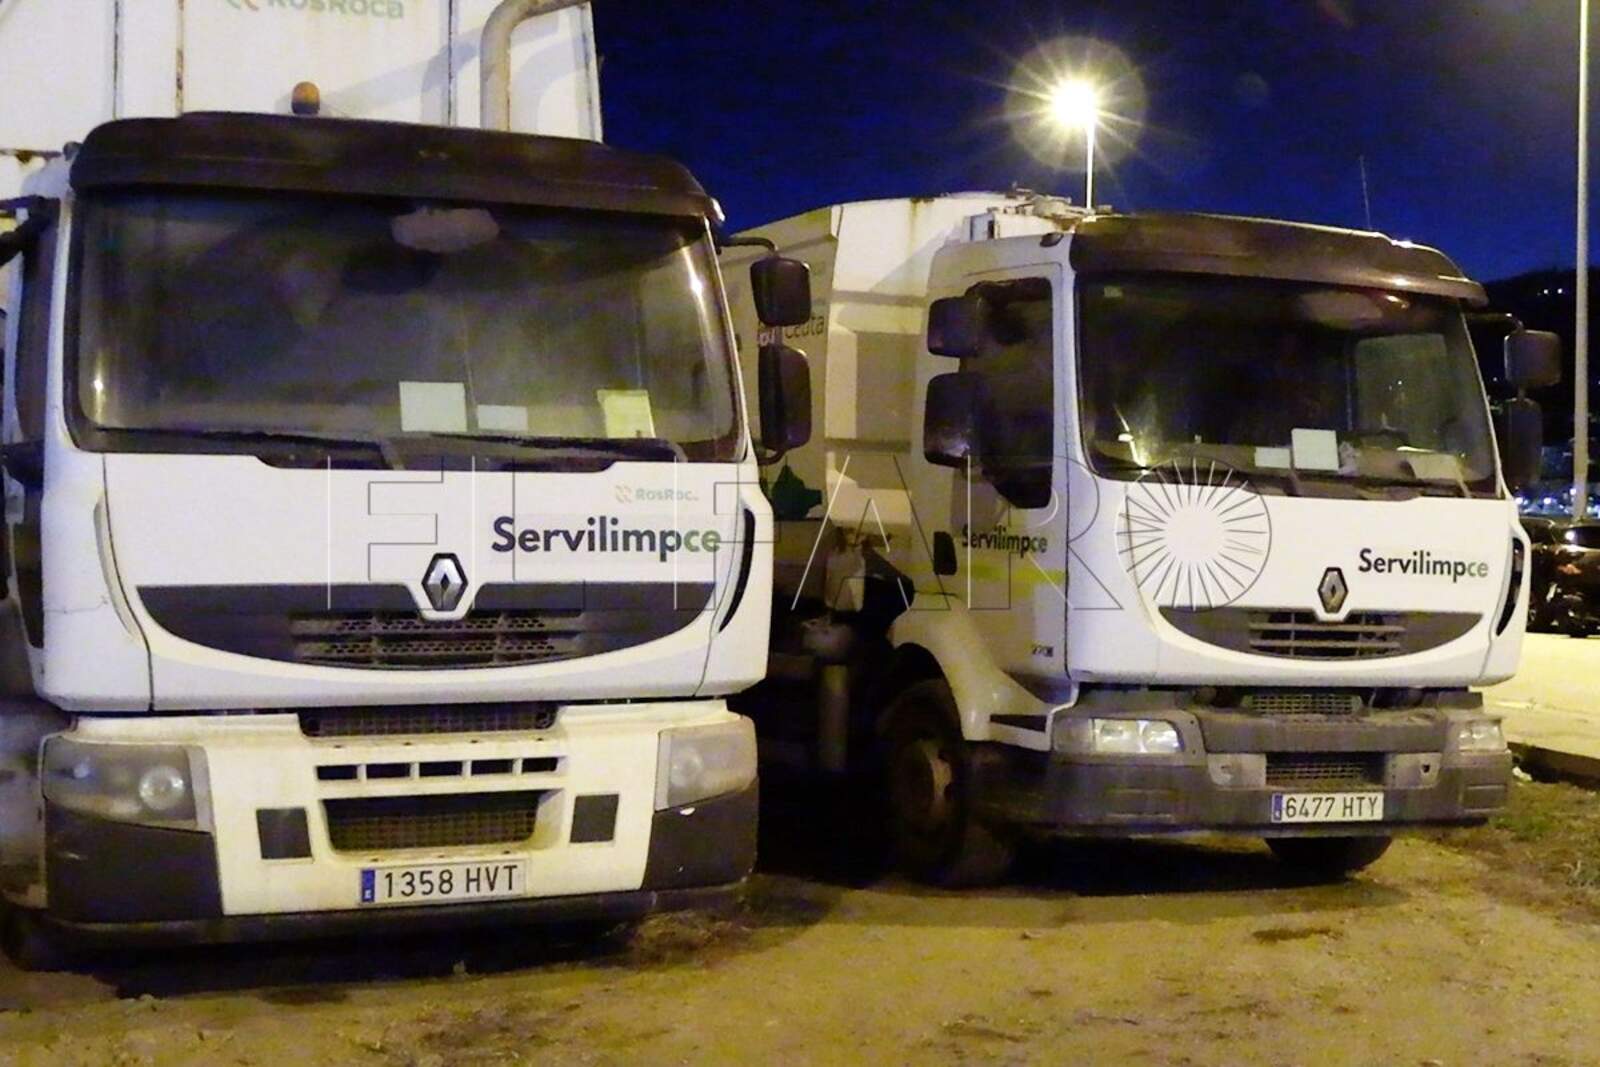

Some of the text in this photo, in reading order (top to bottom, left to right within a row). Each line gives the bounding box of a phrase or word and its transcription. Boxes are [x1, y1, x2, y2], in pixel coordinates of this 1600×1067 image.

[492, 515, 721, 562] Servilimpce
[961, 523, 1049, 558] Servilimpce
[1358, 547, 1489, 583] Servilimpce
[1285, 796, 1336, 818] 6477
[1342, 796, 1378, 817] HTY
[384, 869, 453, 898] 1358
[465, 864, 518, 893] HVT
